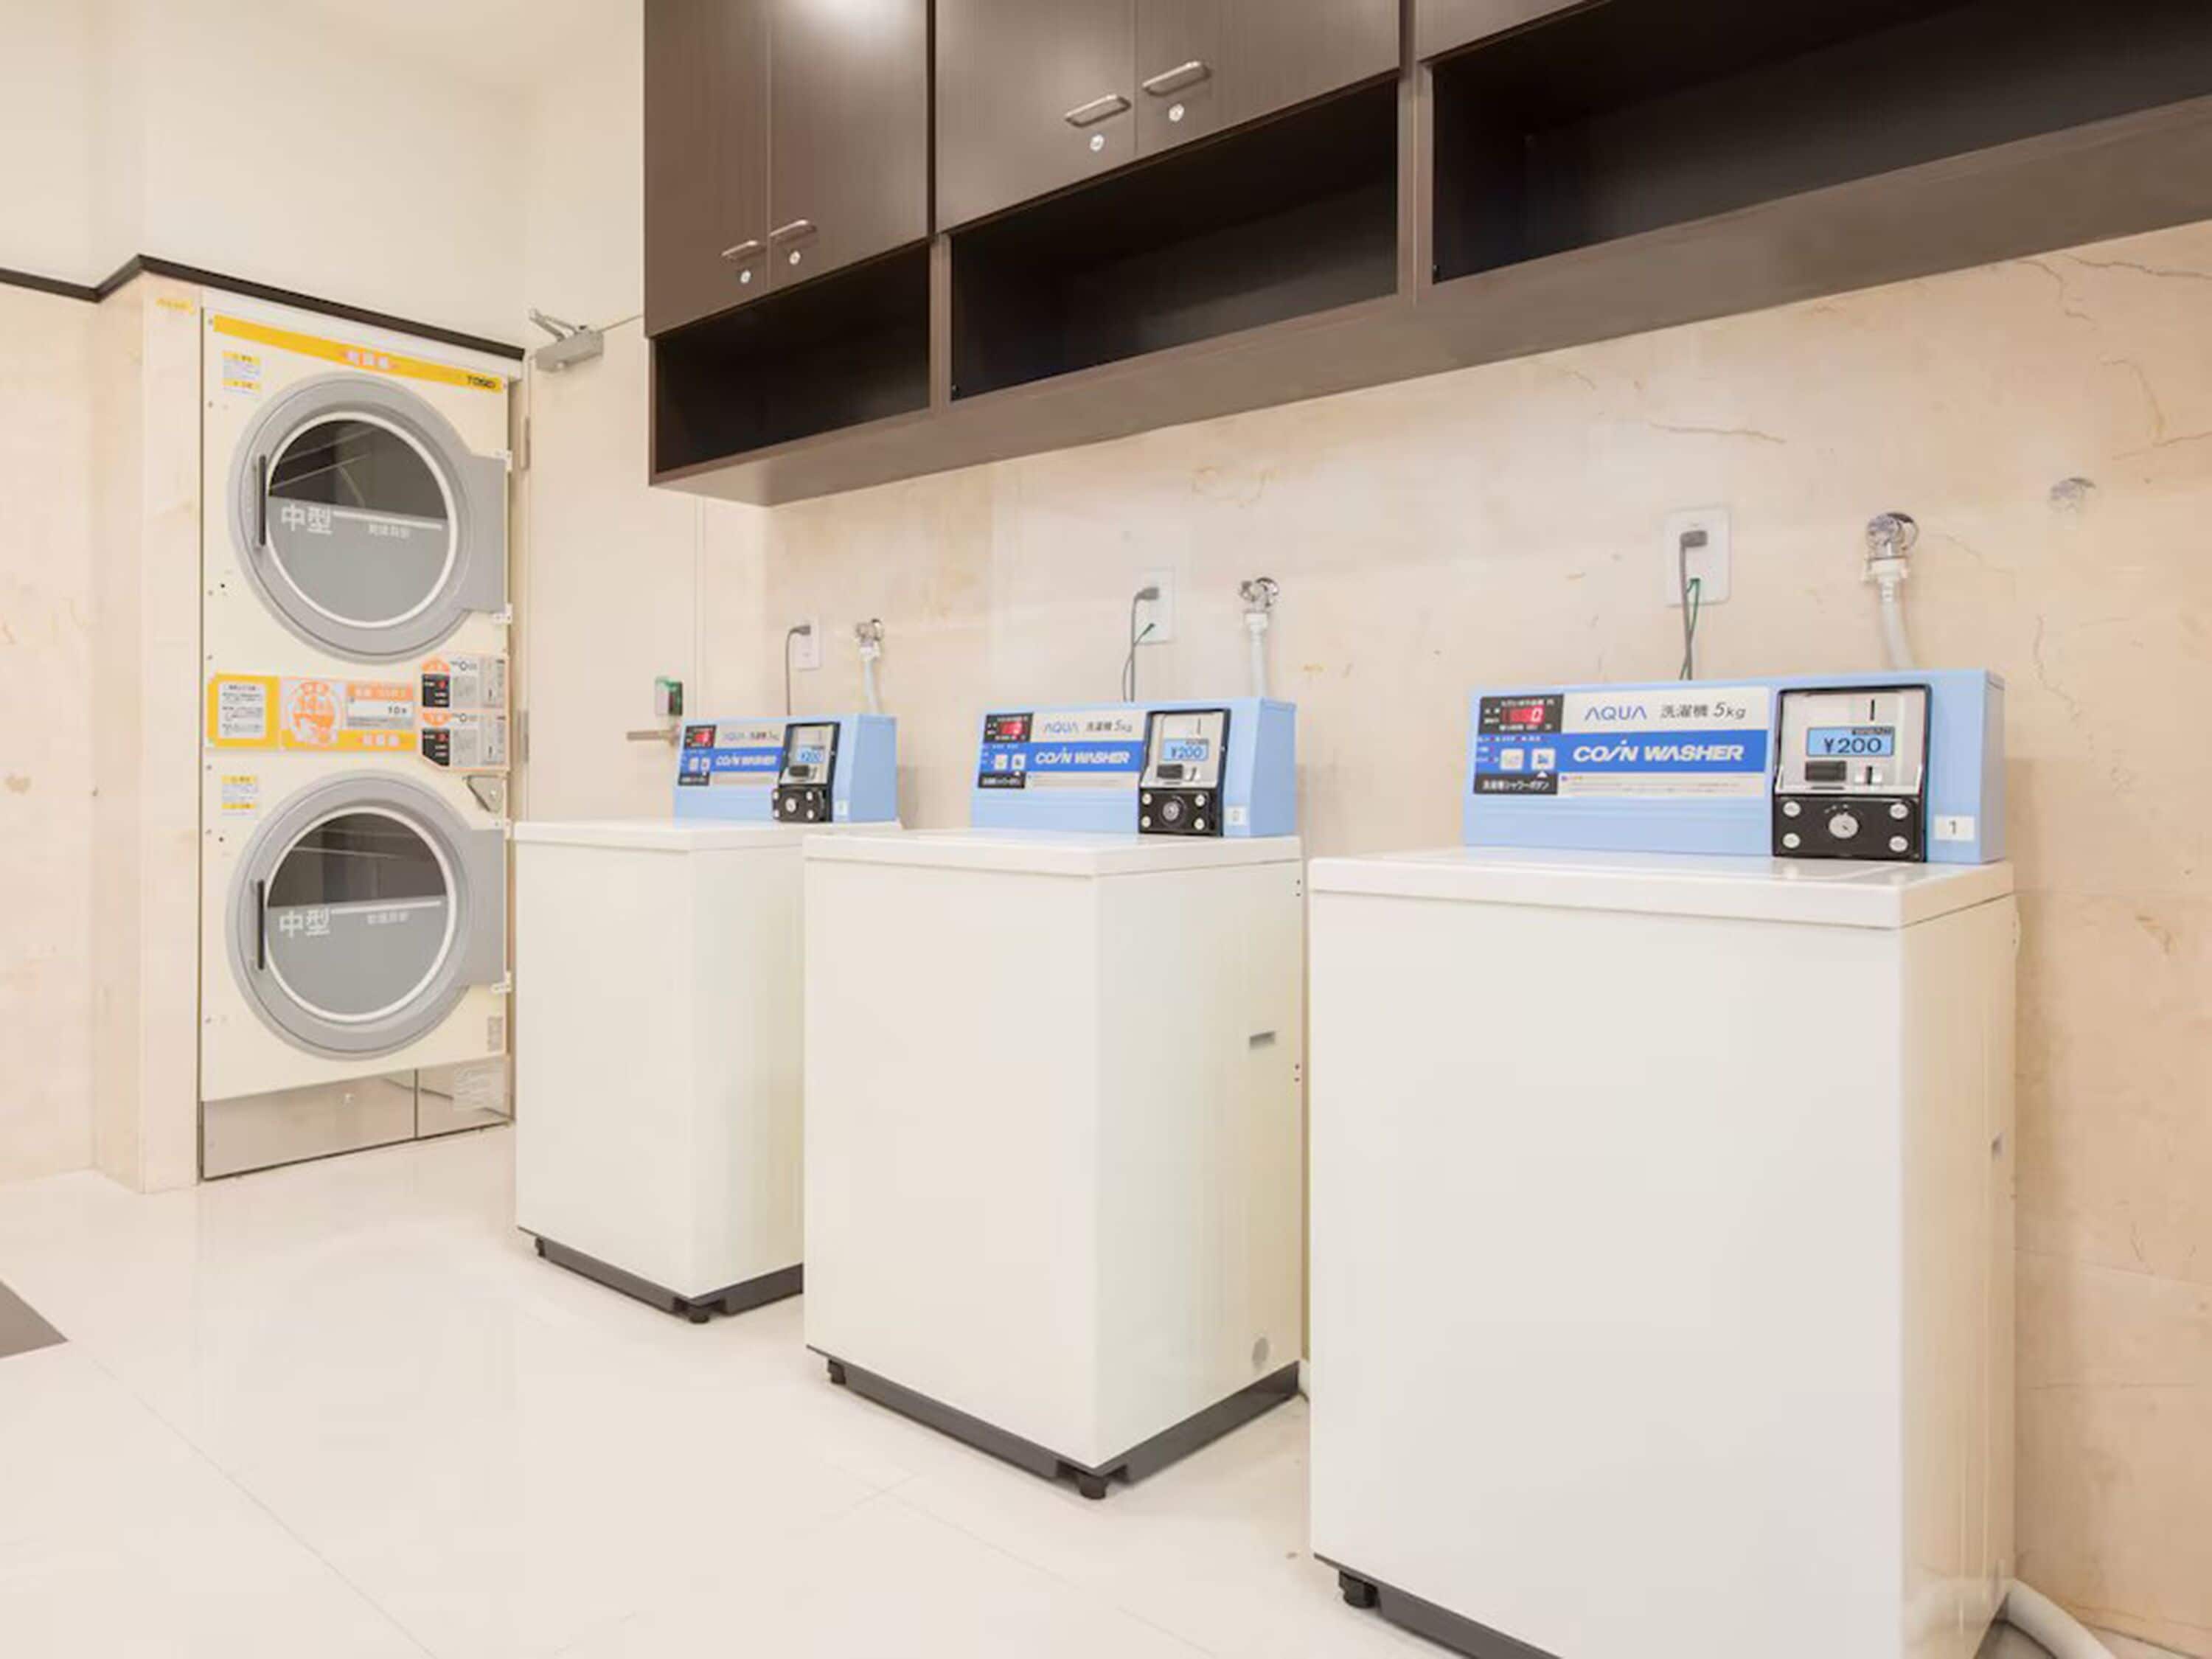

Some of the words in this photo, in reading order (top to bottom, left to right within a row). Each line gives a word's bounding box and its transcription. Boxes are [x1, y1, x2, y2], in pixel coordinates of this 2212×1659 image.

[281, 504, 333, 535] 中型
[1585, 706, 1648, 720] AQUA
[1660, 703, 1708, 720] 洗濯機
[1712, 701, 1747, 720] 5kg
[1644, 744, 1745, 762] WASHER
[1823, 737, 1882, 754] ¥200
[1949, 819, 1957, 835] 1
[279, 910, 330, 938] 中型
